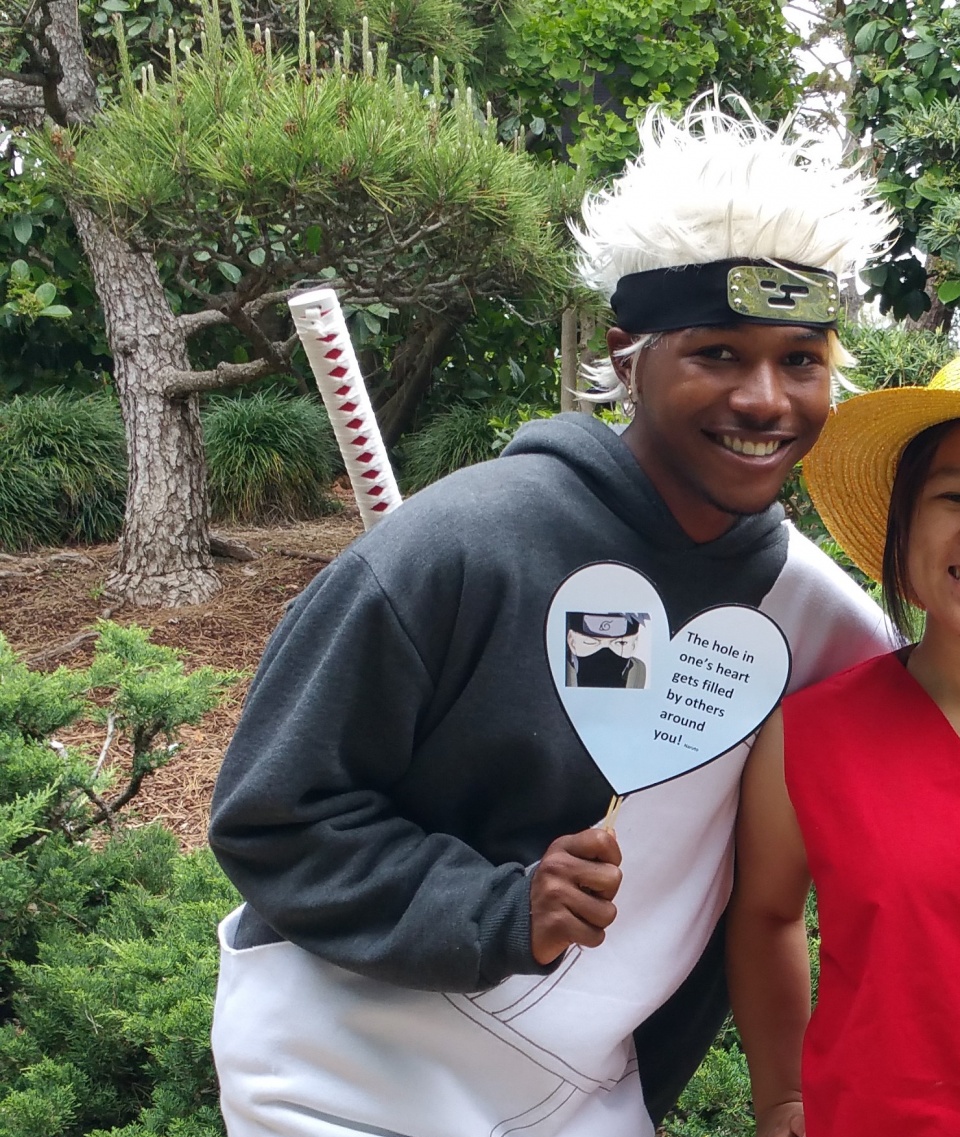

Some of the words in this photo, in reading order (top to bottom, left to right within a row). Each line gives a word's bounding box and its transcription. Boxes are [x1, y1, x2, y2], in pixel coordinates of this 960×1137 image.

[686, 631, 710, 649] The
[712, 640, 740, 659] hole
[742, 650, 755, 664] in
[679, 653, 713, 671] one’s
[715, 663, 750, 684] heart
[671, 672, 699, 687] gets
[701, 679, 735, 700] filled
[666, 688, 682, 704] by
[684, 698, 725, 718] others
[659, 710, 706, 732] around
[653, 728, 683, 746] you!
